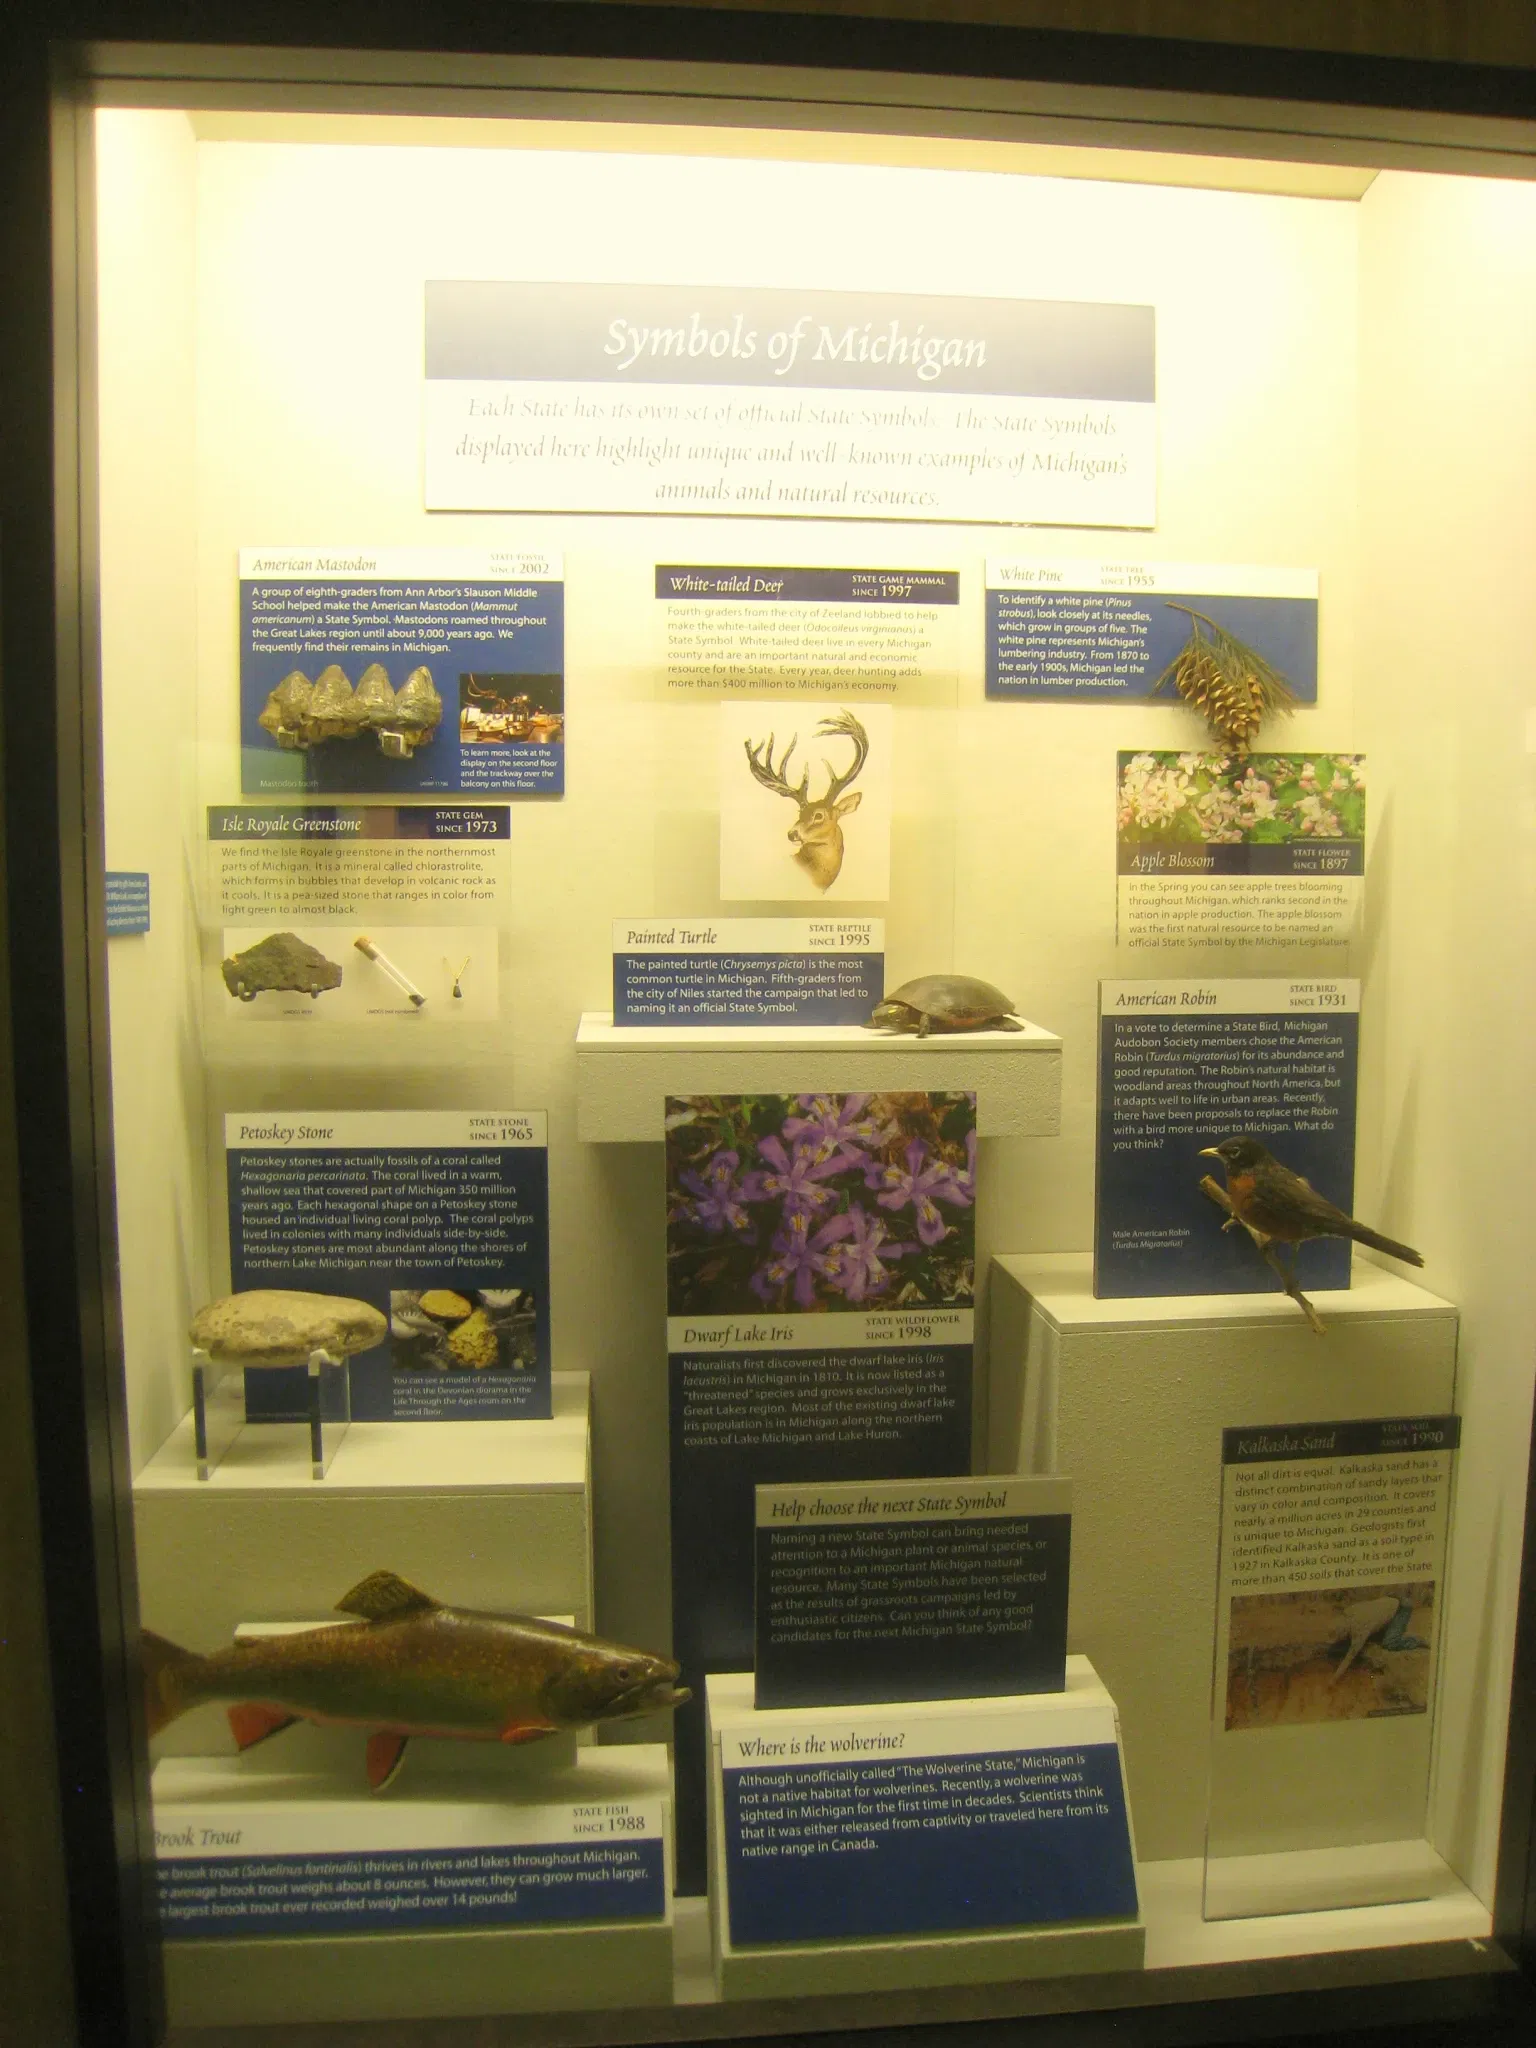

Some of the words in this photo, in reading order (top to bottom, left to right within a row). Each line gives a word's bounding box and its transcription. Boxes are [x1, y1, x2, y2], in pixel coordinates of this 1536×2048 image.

[604, 313, 757, 371] Symbols
[766, 316, 811, 375] of
[811, 319, 986, 381] Michigan
[655, 476, 730, 501] animals
[736, 478, 772, 502] and
[778, 479, 848, 504] natural
[253, 557, 312, 572] American
[316, 557, 376, 571] Mastodon
[852, 575, 877, 584] STATE
[878, 576, 904, 585] GAME
[906, 576, 946, 586] MAMMAL
[1000, 568, 1034, 582] White
[1038, 568, 1062, 582] Pine
[670, 576, 751, 593] White-tailed
[754, 577, 783, 593] Deer
[852, 589, 878, 597] SINCE
[882, 585, 912, 597] 1997
[252, 586, 260, 597] A
[261, 589, 292, 599] group
[293, 587, 304, 597] of
[305, 587, 378, 599] eighth-graders
[379, 587, 403, 598] from
[404, 587, 425, 598] Ann
[427, 587, 462, 598] Arbor's
[463, 587, 502, 598] Slauson
[503, 587, 538, 598] Middle
[252, 642, 302, 654] frequently
[304, 642, 324, 652] find
[326, 642, 349, 652] their
[350, 642, 390, 653] remains
[391, 642, 401, 653] in
[403, 642, 451, 655] Michigan.
[998, 662, 1014, 672] the
[1015, 662, 1038, 675] early
[1040, 662, 1068, 675] 1900s,
[1069, 662, 1112, 676] Michigan
[1113, 663, 1128, 674] led
[1129, 663, 1145, 674] the
[668, 680, 694, 688] more
[696, 678, 722, 688] than
[721, 678, 747, 691] $400
[748, 678, 784, 689] million
[783, 678, 796, 689] to
[797, 679, 850, 692] Michigan's
[850, 682, 899, 692] economy.
[998, 674, 1028, 685] nation
[1029, 675, 1039, 685] in
[1040, 675, 1074, 685] lumber
[1075, 675, 1128, 688] production.
[460, 778, 490, 790] balcony
[502, 778, 516, 788] this
[516, 778, 536, 788] floor.
[435, 811, 461, 820] STATE
[462, 811, 483, 820] GEM
[223, 817, 244, 832] Isle
[247, 817, 290, 836] Royale
[292, 817, 362, 831] Greenstone
[436, 824, 462, 833] SINCE
[466, 820, 497, 833] 1973
[1293, 848, 1316, 856] STATE
[1318, 848, 1351, 857] FLOWER
[1131, 853, 1166, 872] Apple
[1167, 853, 1214, 867] Blossom
[1293, 862, 1317, 870] SINCE
[1320, 858, 1348, 870] 1897
[222, 904, 246, 916] light
[246, 906, 277, 916] green
[279, 904, 290, 914] to
[292, 904, 327, 914] almost
[809, 924, 834, 933] STATE
[836, 924, 872, 933] REPTILE
[627, 929, 675, 944] Painted
[679, 929, 717, 944] Turtle
[809, 938, 835, 946] SINCE
[840, 934, 870, 946] 1995
[1290, 984, 1314, 993] STATE
[1315, 984, 1337, 993] BIRD
[1116, 990, 1176, 1006] American
[1180, 990, 1216, 1005] Robin
[1290, 998, 1314, 1006] SINCE
[1318, 995, 1346, 1006] 1931
[627, 1002, 666, 1014] naming
[668, 1002, 676, 1012] it
[692, 1002, 727, 1012] official
[727, 1002, 755, 1012] State
[757, 1002, 798, 1014] Symbol.
[470, 1119, 495, 1128] STATE
[498, 1119, 528, 1127] STONE
[1113, 1125, 1136, 1135] with
[1136, 1127, 1144, 1135] a
[1145, 1124, 1167, 1134] bird
[1166, 1126, 1194, 1134] more
[1195, 1123, 1230, 1136] unique
[1232, 1123, 1243, 1133] to
[1244, 1122, 1290, 1135] Michigan.
[1294, 1121, 1319, 1131] What
[1320, 1121, 1334, 1131] do
[240, 1124, 294, 1145] Petoskey
[297, 1124, 333, 1139] Stone
[470, 1133, 497, 1141] SINCE
[501, 1129, 533, 1140] 1965
[244, 1258, 290, 1268] northern
[292, 1258, 316, 1268] Lake
[319, 1257, 368, 1270] Michigan
[369, 1260, 392, 1268] near
[395, 1257, 412, 1268] the
[414, 1257, 442, 1267] town
[443, 1257, 456, 1267] of
[456, 1257, 504, 1269] Petoskey.
[866, 1318, 893, 1327] STATE
[895, 1316, 960, 1326] WILDFLOWER
[684, 1325, 732, 1348] Dwarf
[734, 1324, 766, 1342] Lake
[770, 1324, 793, 1341] Iris
[866, 1331, 894, 1340] SINCE
[898, 1327, 932, 1339] 1998
[684, 1434, 718, 1446] coasts
[720, 1434, 732, 1445] of
[734, 1433, 761, 1444] Lake
[760, 1432, 813, 1446] Michigan
[814, 1431, 836, 1442] and
[838, 1430, 863, 1441] Lake
[1412, 1432, 1444, 1446] 1990
[772, 1498, 806, 1522] Help
[809, 1496, 854, 1516] choose
[858, 1495, 879, 1514] the
[882, 1494, 914, 1513] next
[917, 1492, 952, 1511] State
[954, 1490, 1007, 1514] Symbol
[739, 1737, 786, 1757] Where
[790, 1736, 800, 1754] is
[804, 1735, 826, 1754] the
[830, 1732, 905, 1753] wolverine?
[573, 1807, 602, 1817] STATE
[605, 1806, 628, 1816] FISH
[573, 1823, 603, 1833] SINCE
[610, 1817, 645, 1832] 1988
[201, 1828, 241, 1846] Trout
[742, 1844, 778, 1857] native
[781, 1845, 815, 1858] range
[817, 1841, 829, 1853] in
[831, 1839, 878, 1853] Canada.
